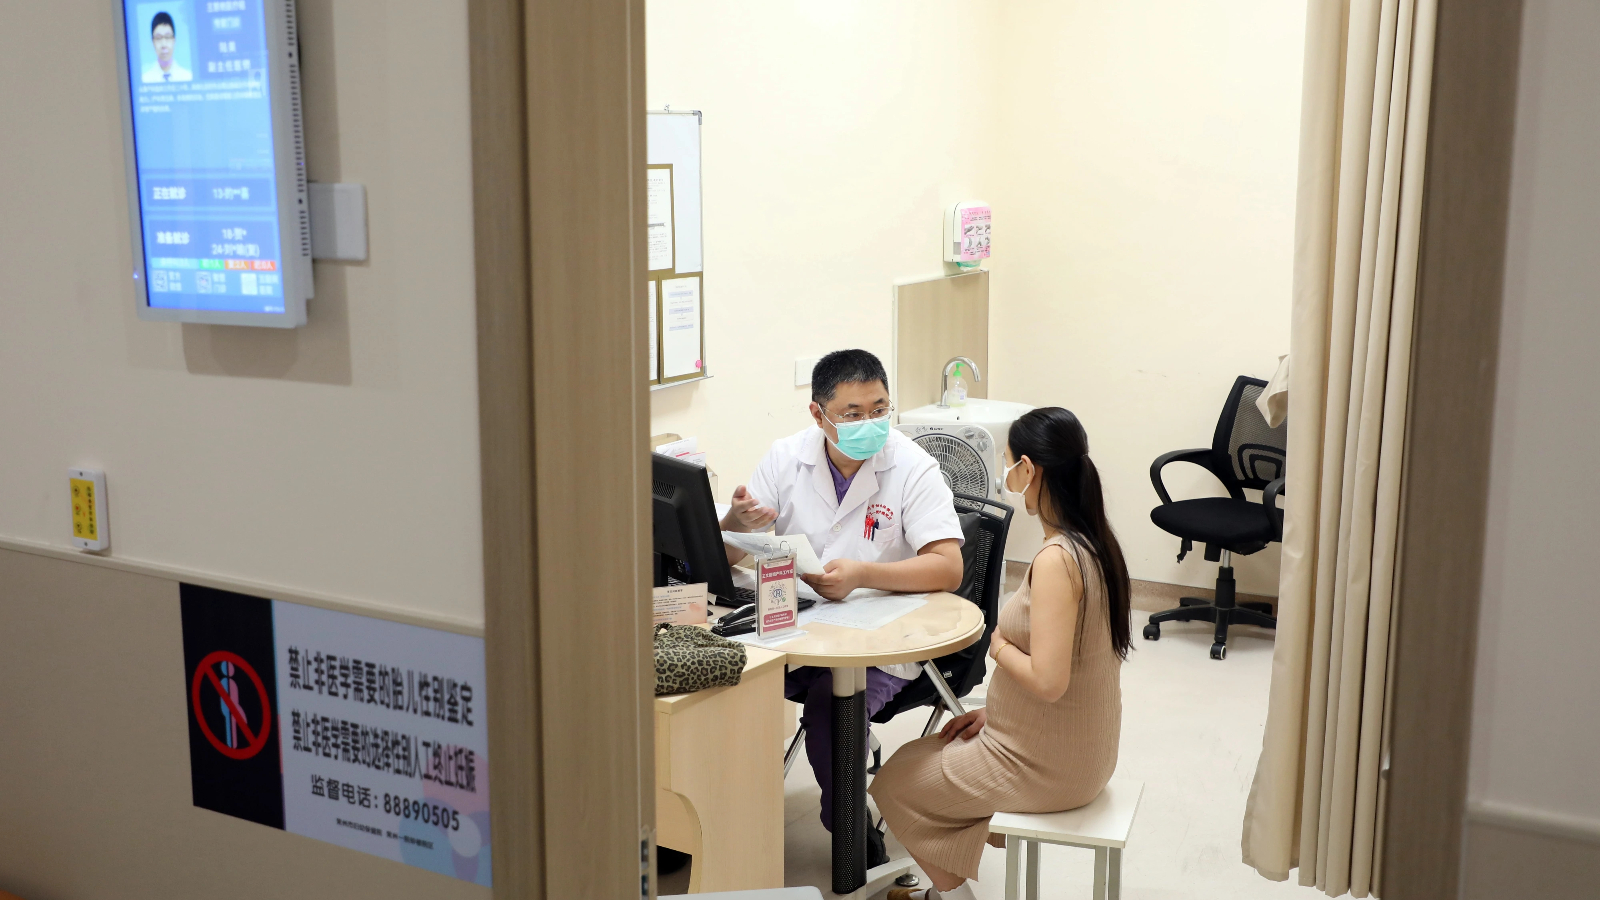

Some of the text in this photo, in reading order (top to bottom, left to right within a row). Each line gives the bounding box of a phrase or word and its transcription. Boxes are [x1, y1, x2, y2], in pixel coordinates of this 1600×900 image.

[288, 645, 474, 727] 禁止非医学需要的胎儿性别鉴定
[291, 708, 476, 794] 禁止非医学需要的选择性别人工终止妊娠
